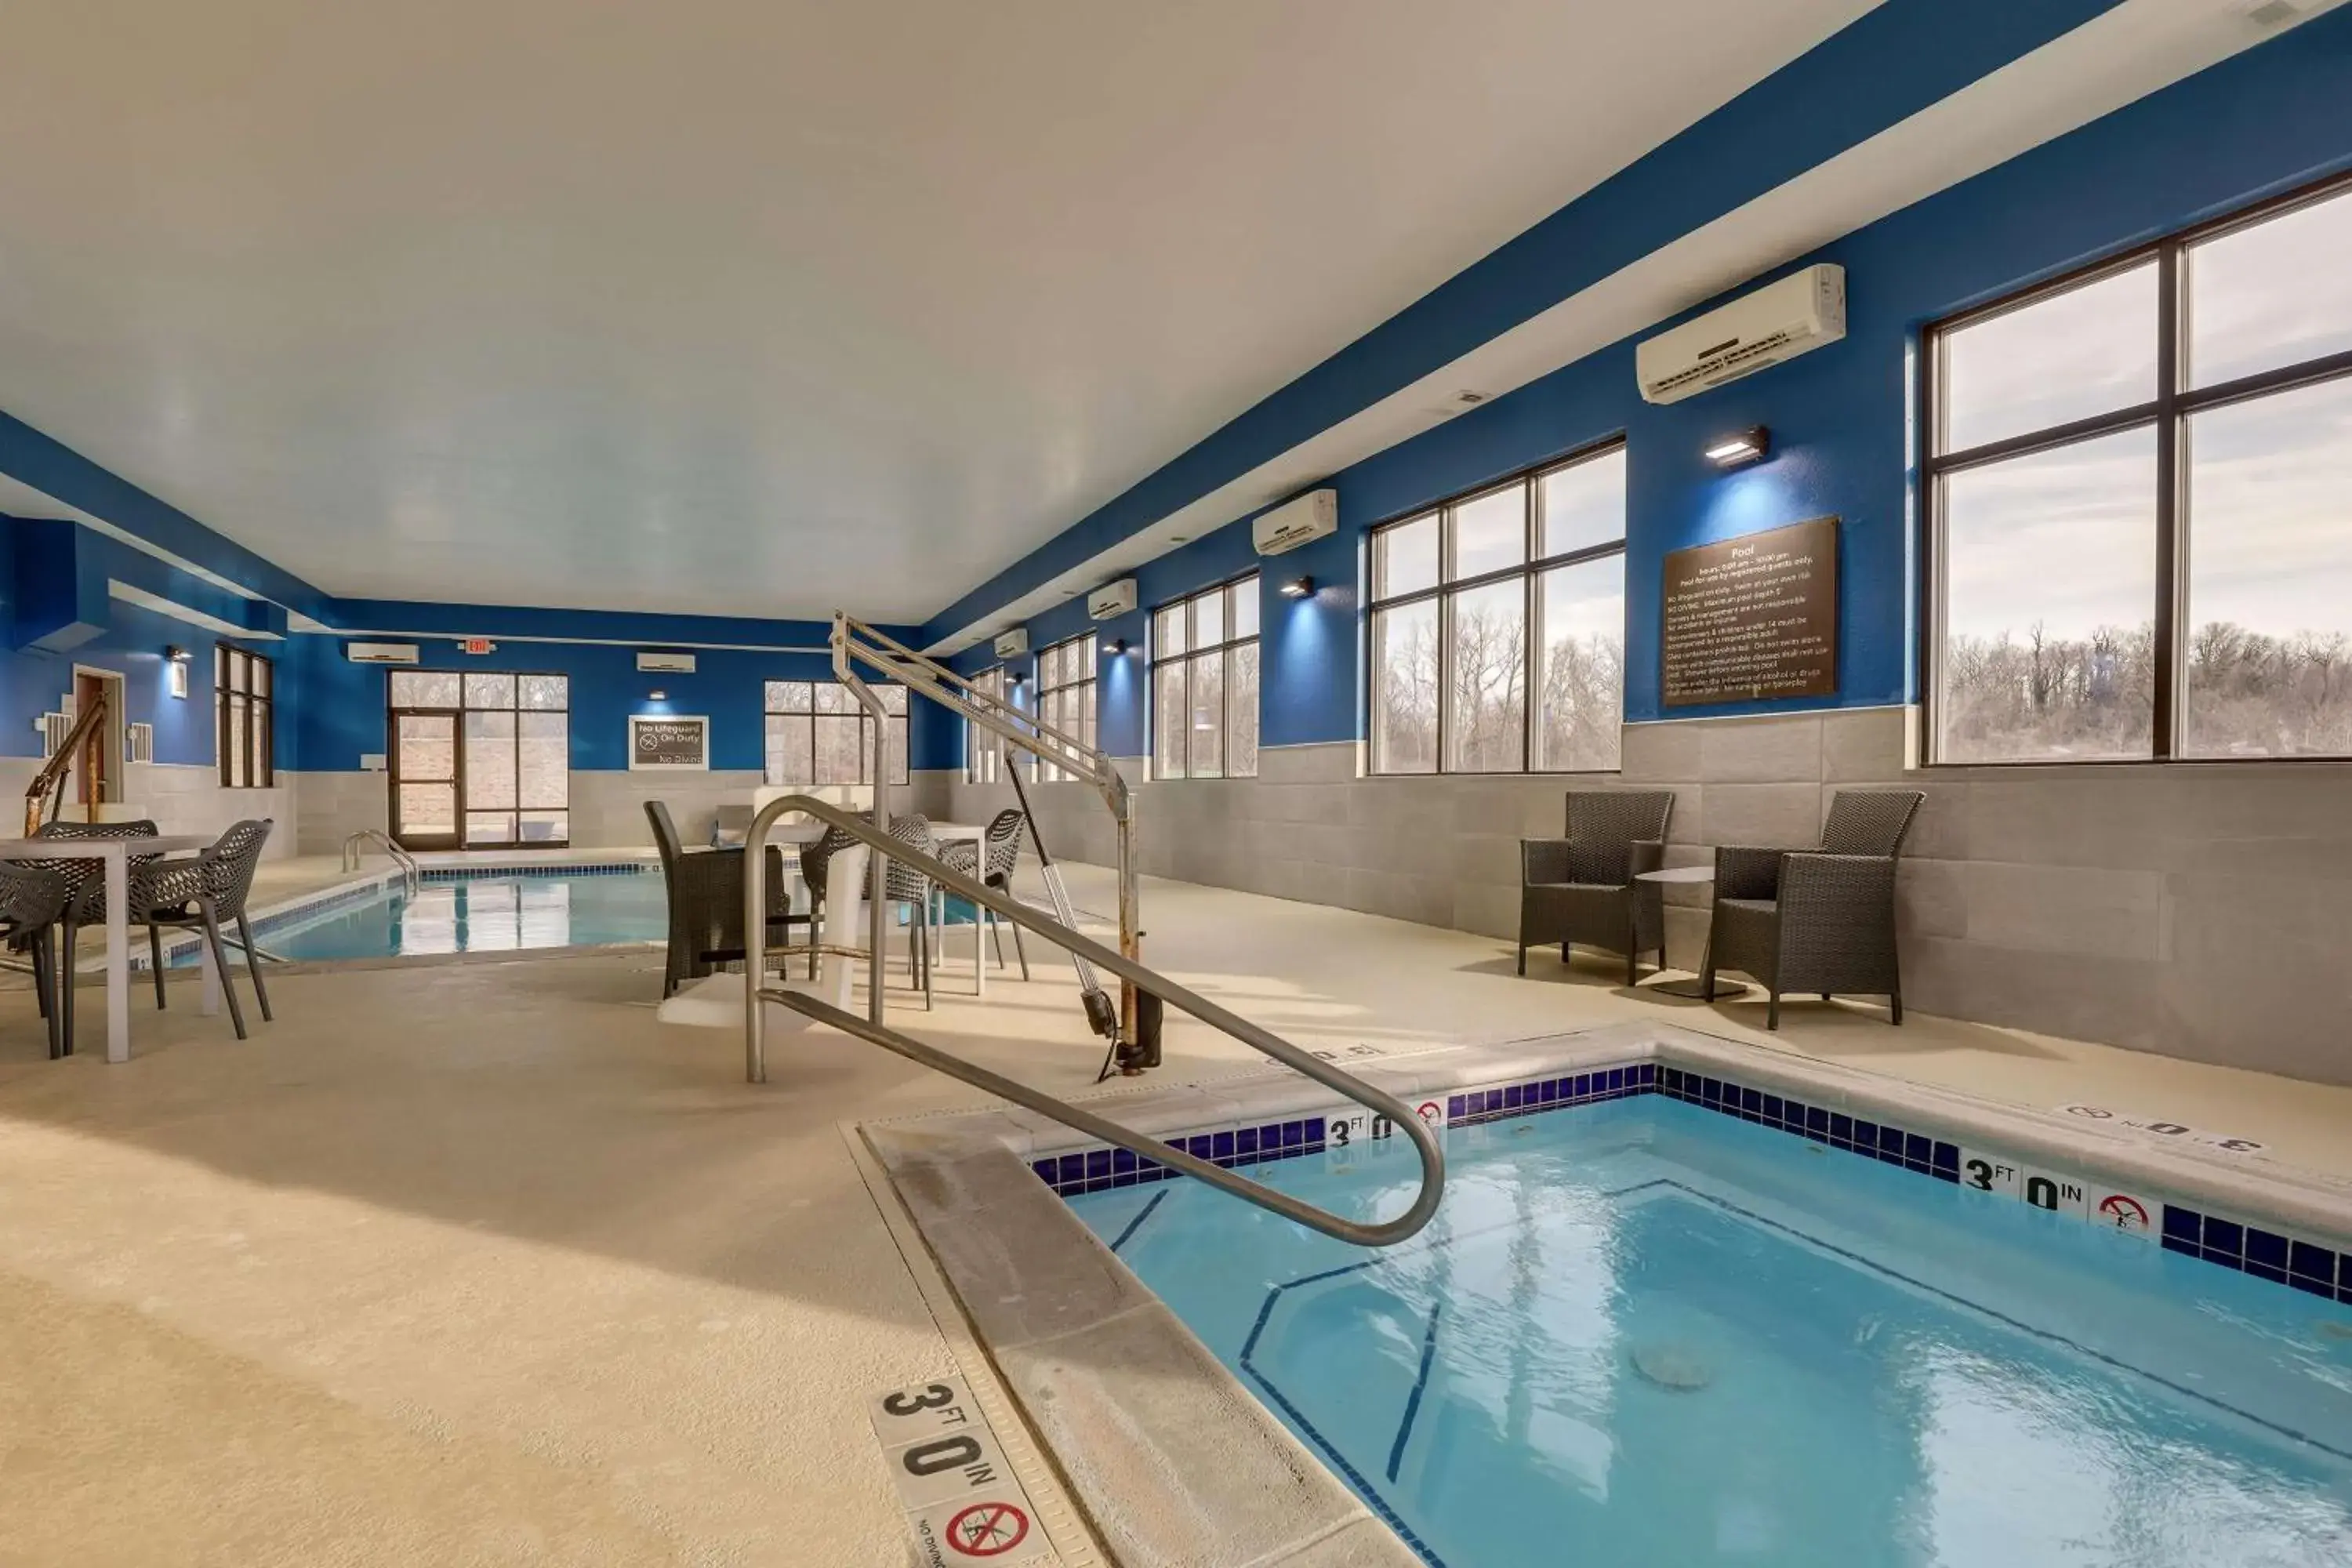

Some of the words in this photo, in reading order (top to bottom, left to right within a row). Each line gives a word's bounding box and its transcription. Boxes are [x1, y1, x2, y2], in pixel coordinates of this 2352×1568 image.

[1731, 543, 1754, 559] Pool
[639, 724, 653, 732] No
[655, 724, 700, 735] Lifeguard
[661, 733, 675, 742] On
[677, 733, 700, 744] Duty
[1331, 1120, 1349, 1148] 3
[1351, 1116, 1364, 1130] FT
[1965, 1159, 1993, 1191] 3
[1995, 1165, 2016, 1181] FT
[2027, 1177, 2058, 1210] 0
[2061, 1183, 2082, 1203] IN
[884, 1384, 954, 1417] 3
[936, 1406, 967, 1425] FT
[903, 1436, 982, 1476] 0
[964, 1462, 997, 1486] IN
[917, 1519, 931, 1533] NO
